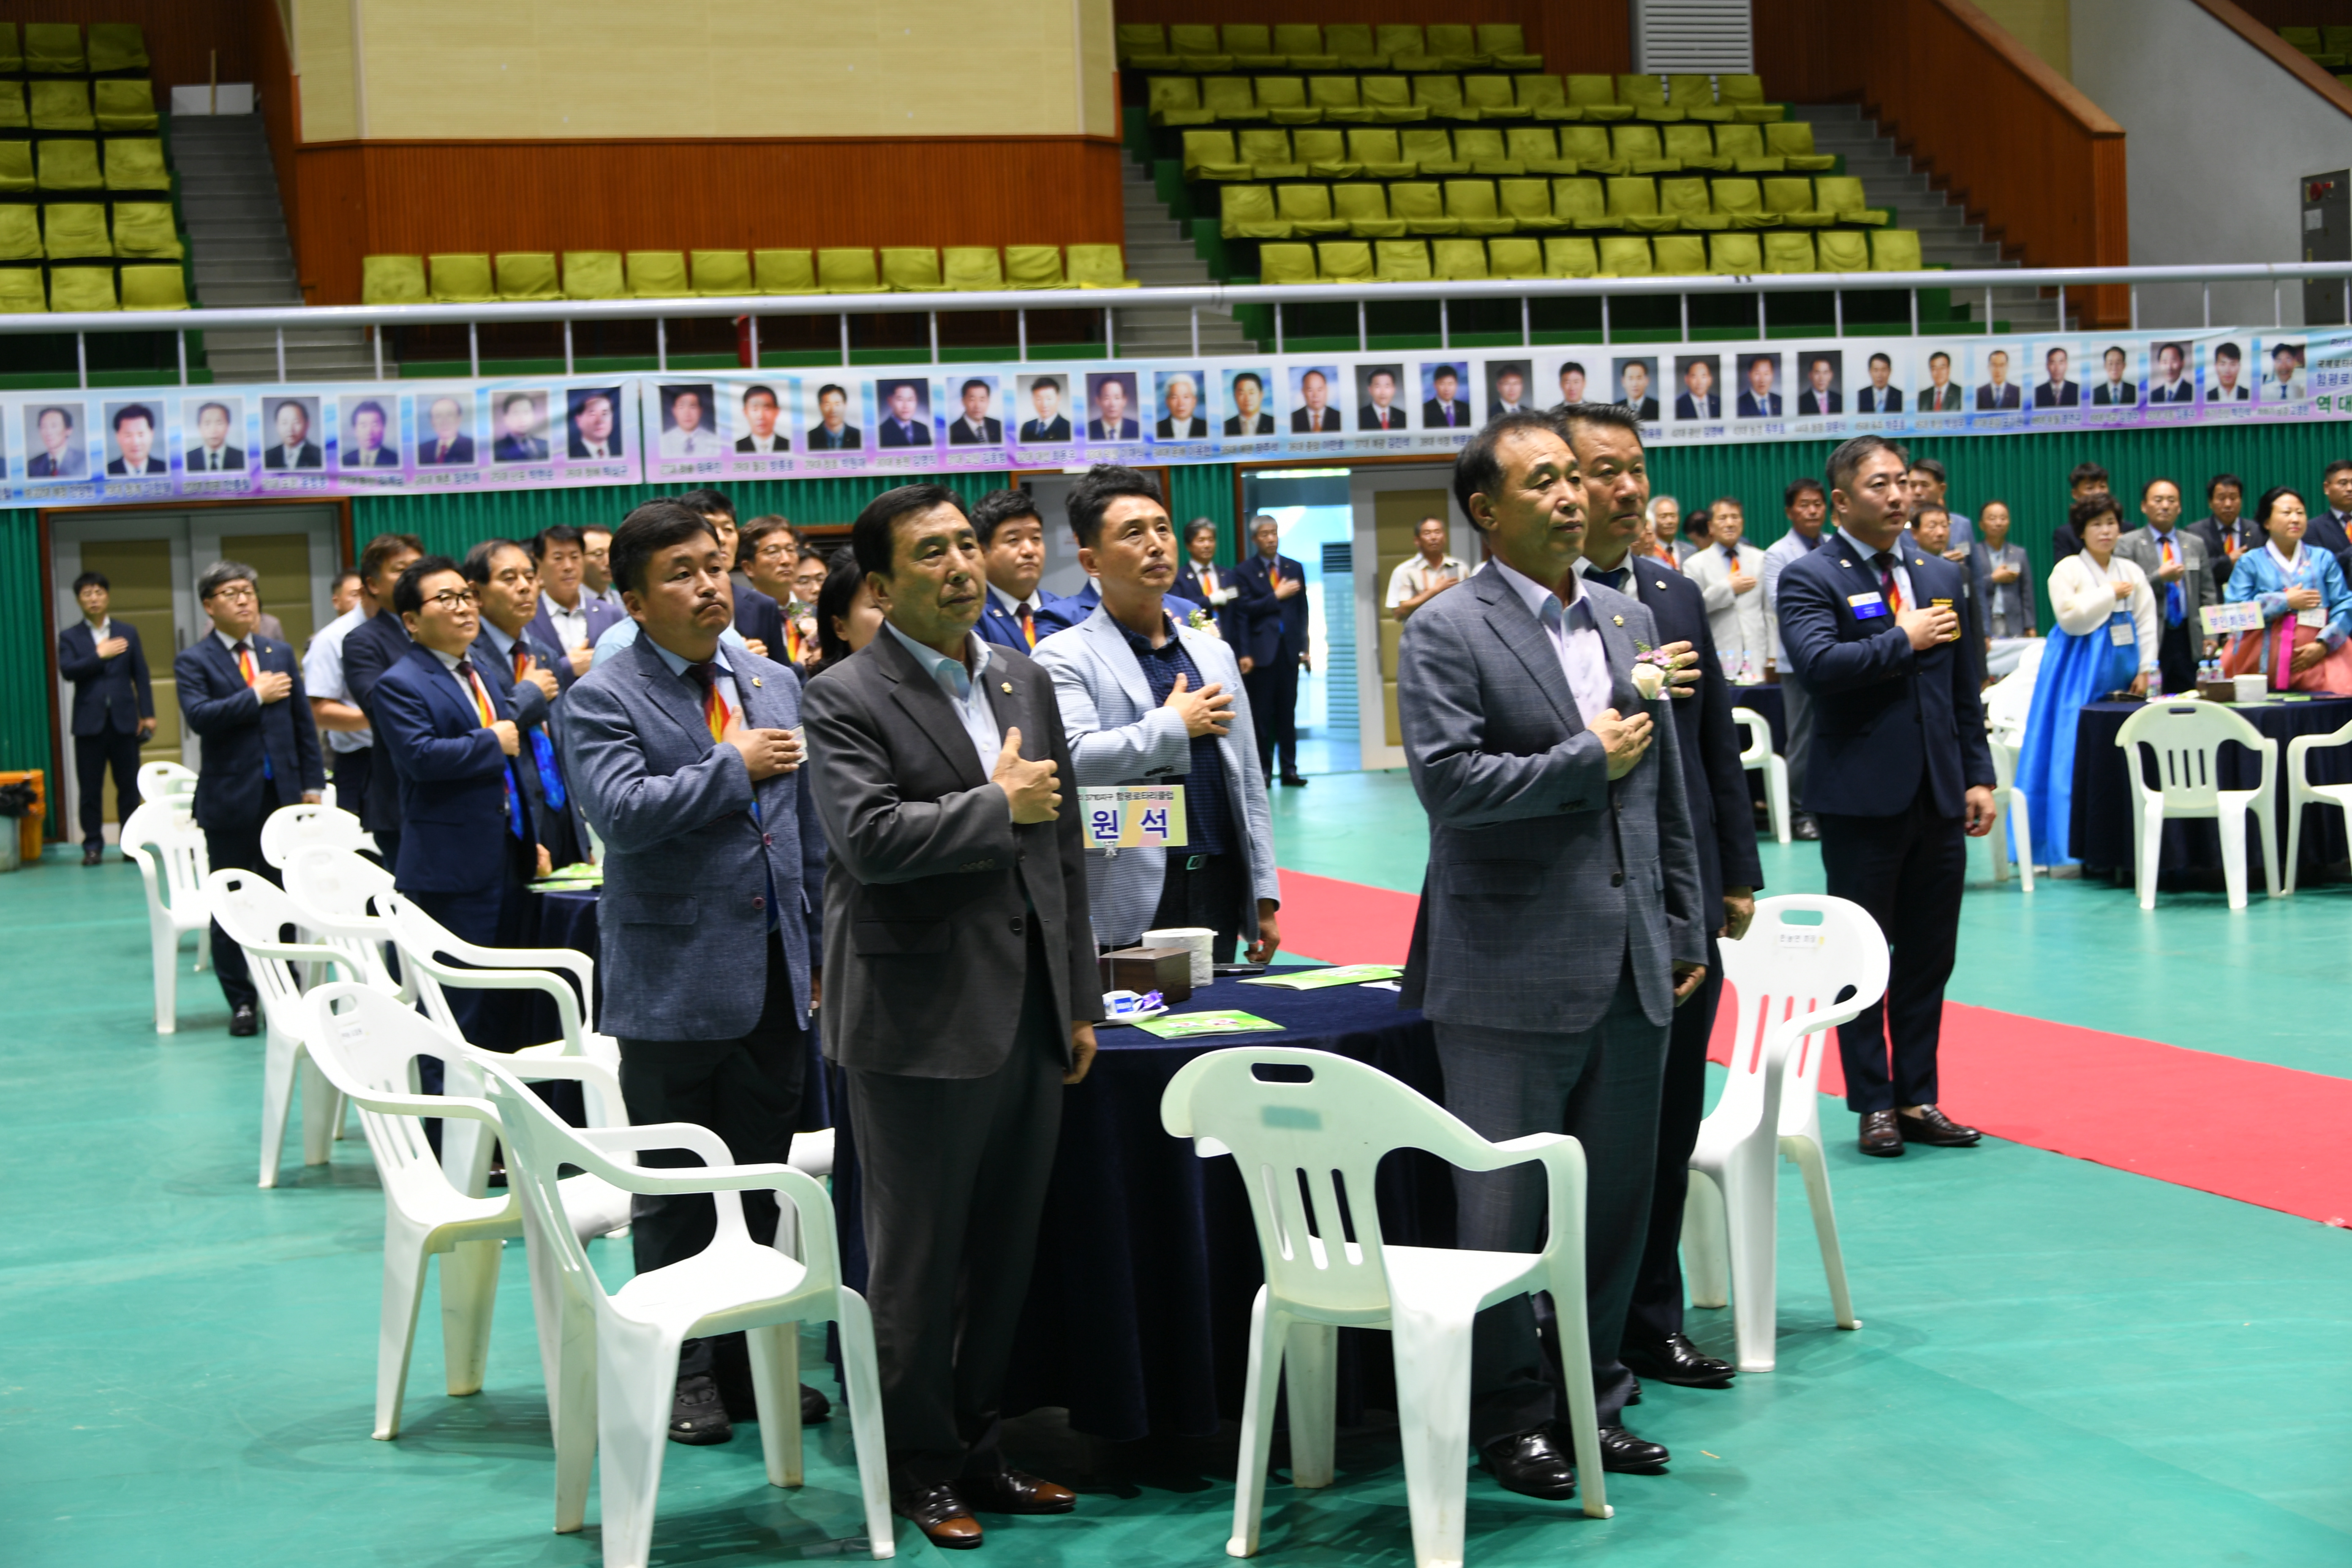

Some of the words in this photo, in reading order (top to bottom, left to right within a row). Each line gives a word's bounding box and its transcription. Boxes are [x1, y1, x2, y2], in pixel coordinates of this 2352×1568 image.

[2317, 359, 2352, 368] 국제로타
[2317, 373, 2352, 387] 함평로
[1116, 791, 1174, 801] 함평로타리클럽
